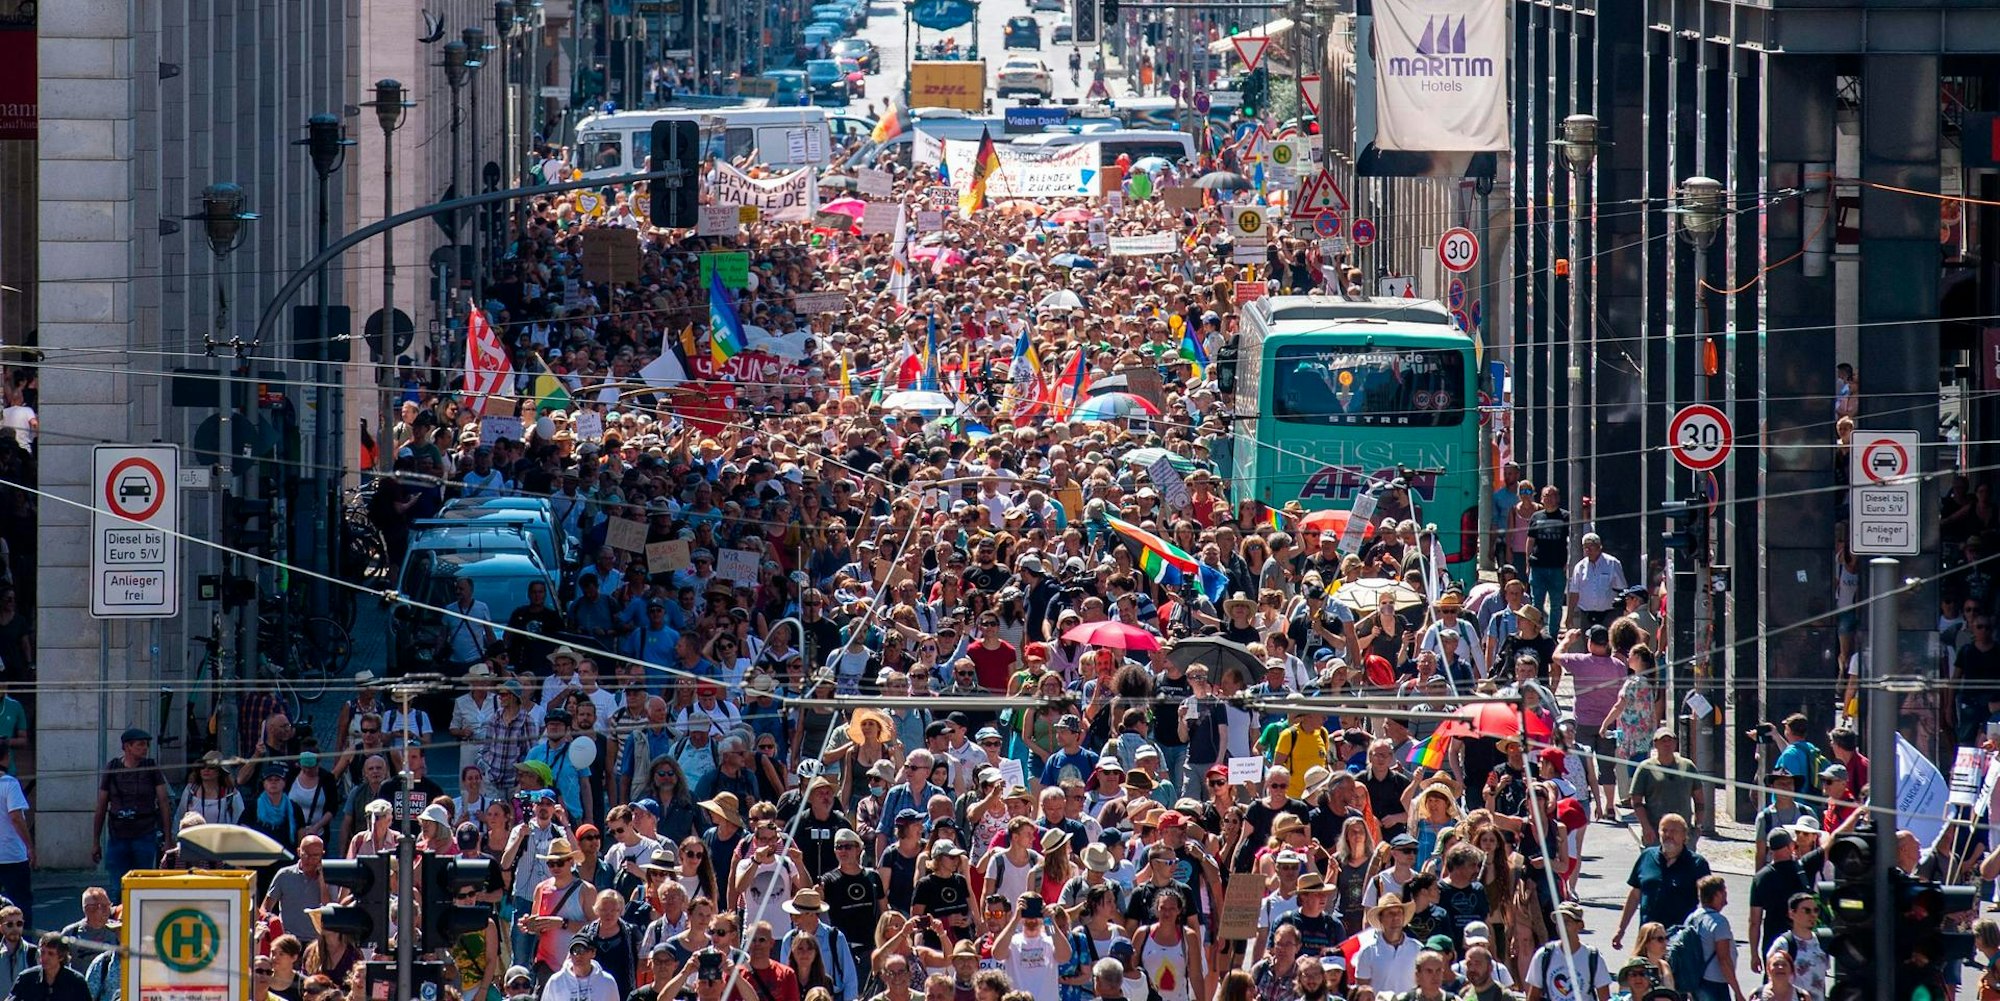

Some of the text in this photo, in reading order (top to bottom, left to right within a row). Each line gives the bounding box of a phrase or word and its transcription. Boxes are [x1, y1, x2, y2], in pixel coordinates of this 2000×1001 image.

[1389, 57, 1493, 77] MARITIM
[924, 84, 967, 95] DHL
[1421, 80, 1463, 92] Hotels
[1007, 115, 1036, 125] Vielen
[718, 187, 807, 209] HALLE.DE
[1447, 240, 1470, 260] 30
[1328, 416, 1409, 424] SETRA
[1682, 424, 1719, 450] 30
[1276, 439, 1460, 474] REISEN
[1865, 494, 1904, 503] Diesel bis
[1866, 504, 1903, 512] Euro 5/V
[1866, 525, 1902, 536] Anlieger
[108, 533, 161, 545] Diesel bis
[1877, 534, 1892, 544] frei
[109, 549, 159, 560] Euro 5/V
[110, 575, 158, 589] Anlieger
[124, 590, 144, 601] frei
[171, 923, 202, 958] H
